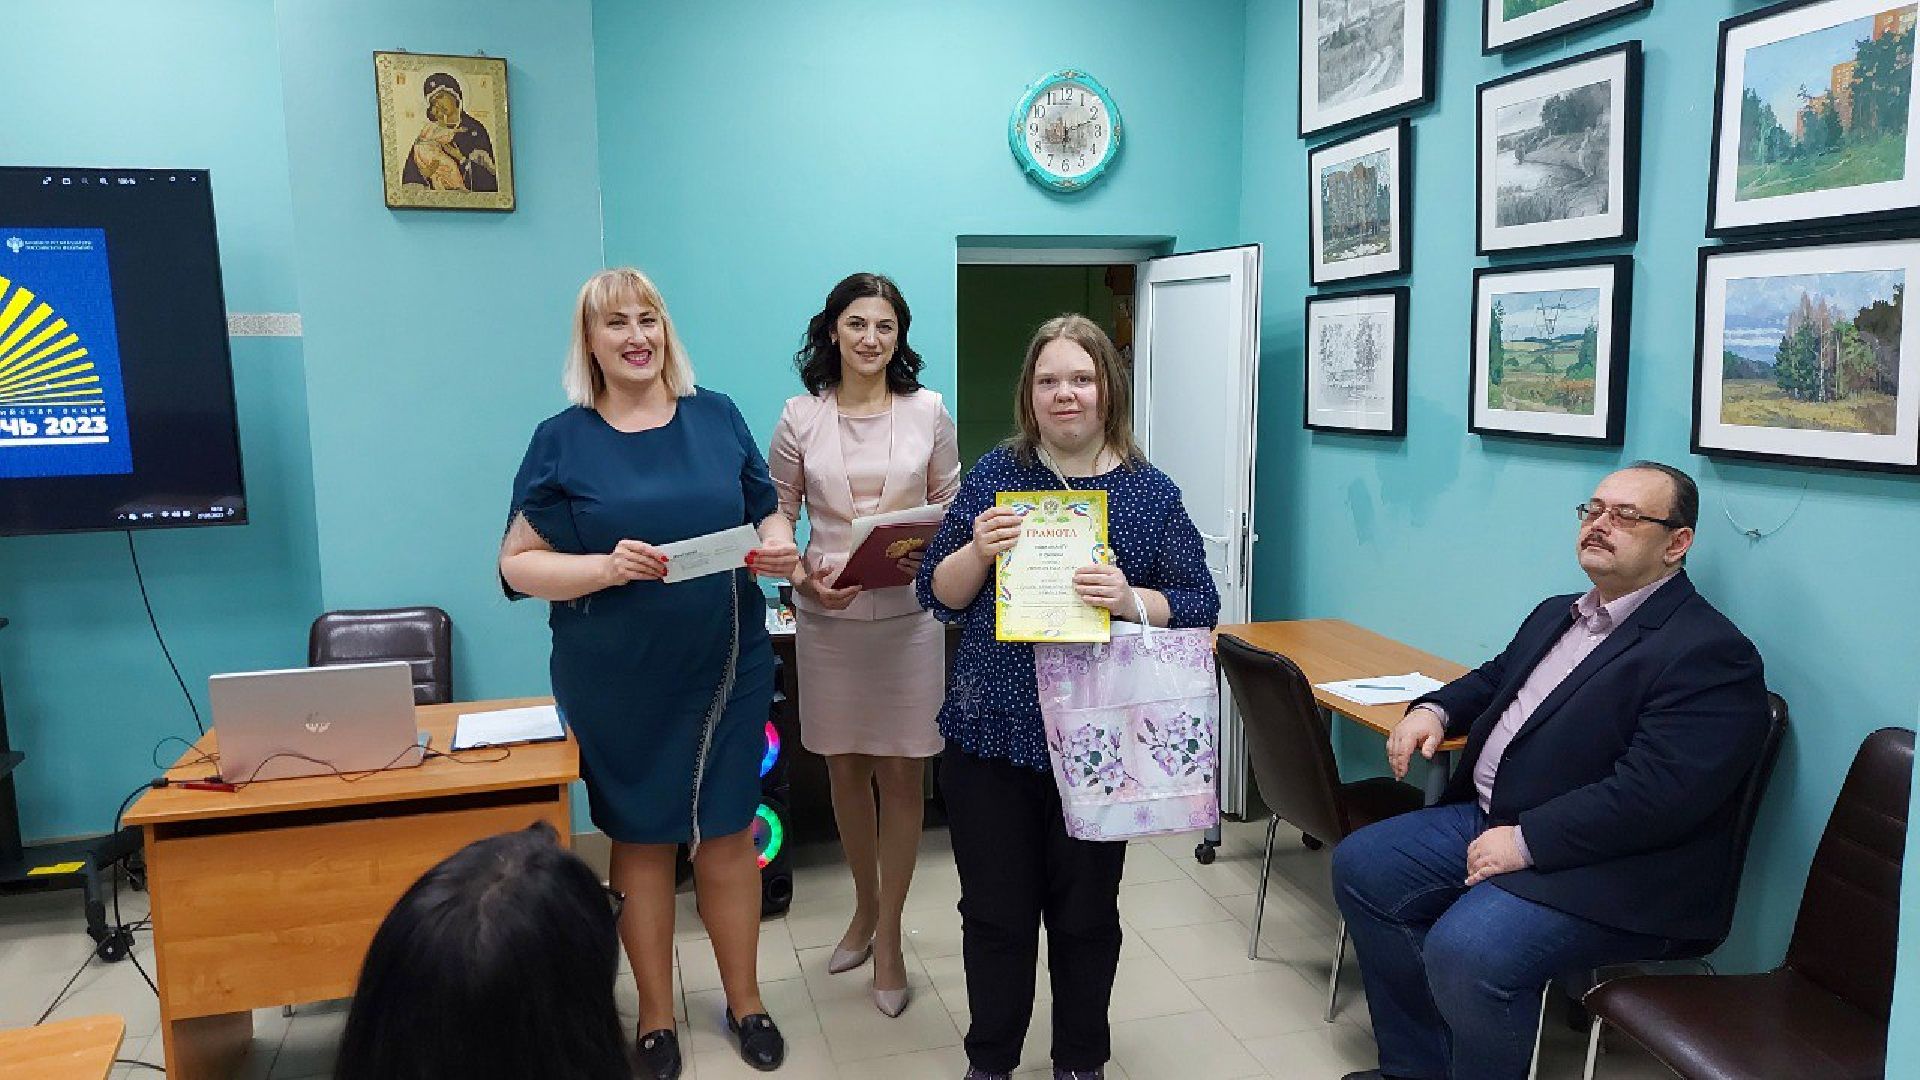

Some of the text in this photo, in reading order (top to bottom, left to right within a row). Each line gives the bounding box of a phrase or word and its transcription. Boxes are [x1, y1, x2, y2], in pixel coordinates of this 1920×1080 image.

[1047, 92, 1057, 105] 11
[1061, 88, 1073, 101] 12
[1080, 93, 1085, 106] 1
[1033, 105, 1046, 118] 10
[1090, 106, 1099, 120] 2
[1030, 123, 1039, 136] 9
[1095, 124, 1102, 138] 3
[1034, 141, 1042, 154] 8
[1090, 143, 1096, 154] 4
[1047, 154, 1055, 167] 7
[1062, 158, 1070, 172] 6
[1078, 154, 1085, 168] 5
[43, 416, 109, 435] 2023
[1026, 528, 1078, 538] ГРАМОТА
